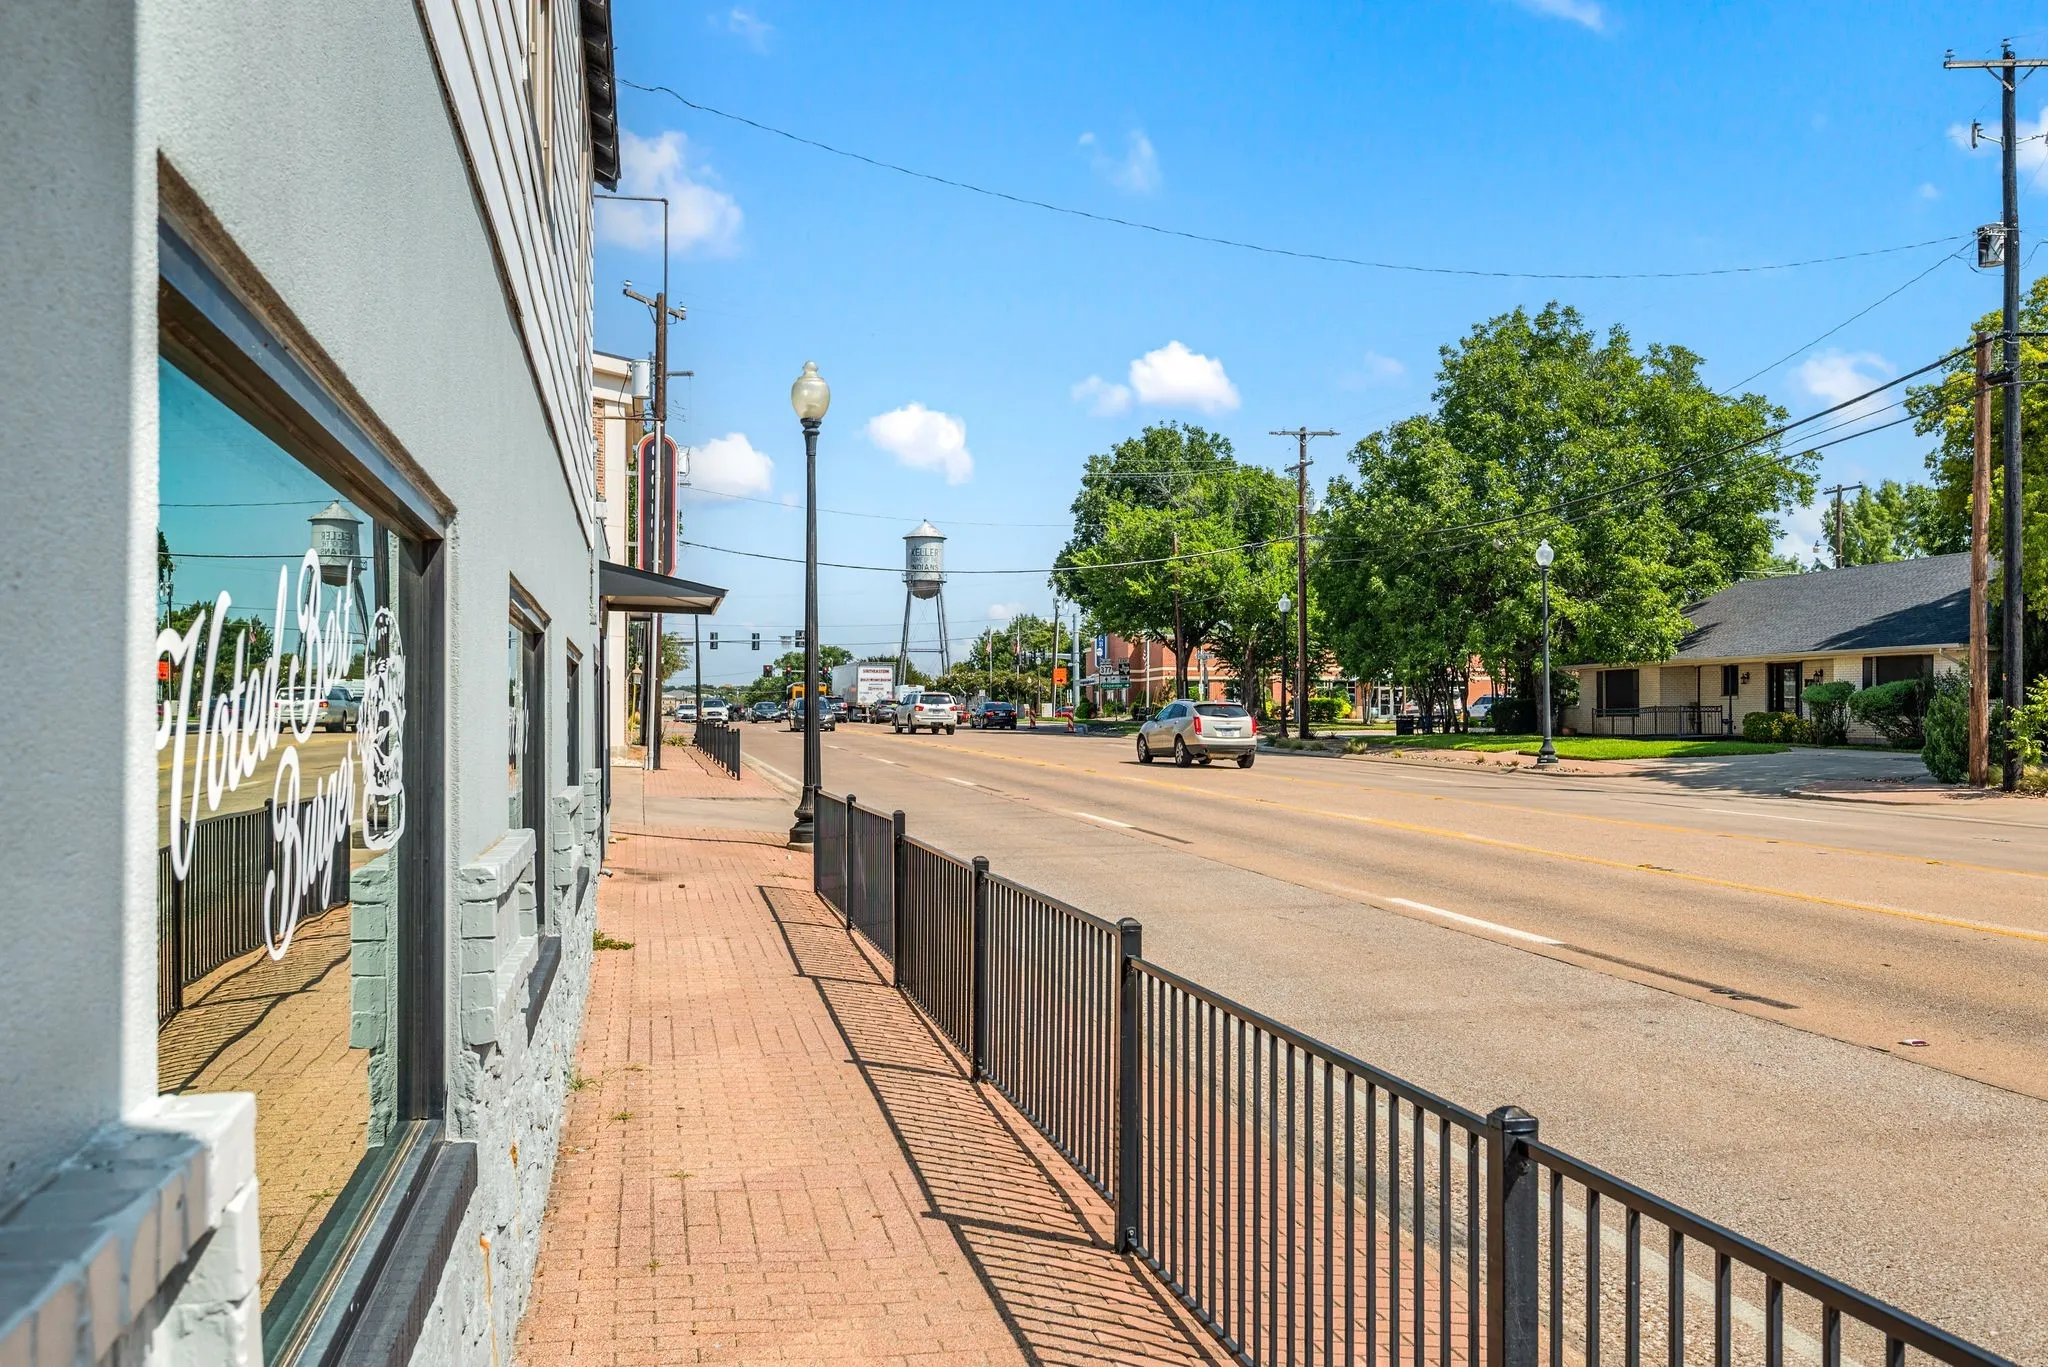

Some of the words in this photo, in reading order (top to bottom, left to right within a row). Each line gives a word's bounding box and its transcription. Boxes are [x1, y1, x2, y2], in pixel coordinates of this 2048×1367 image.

[911, 547, 939, 557] KELLER
[157, 564, 288, 881] Voted
[289, 548, 353, 743] Best
[264, 746, 356, 960] Burger
